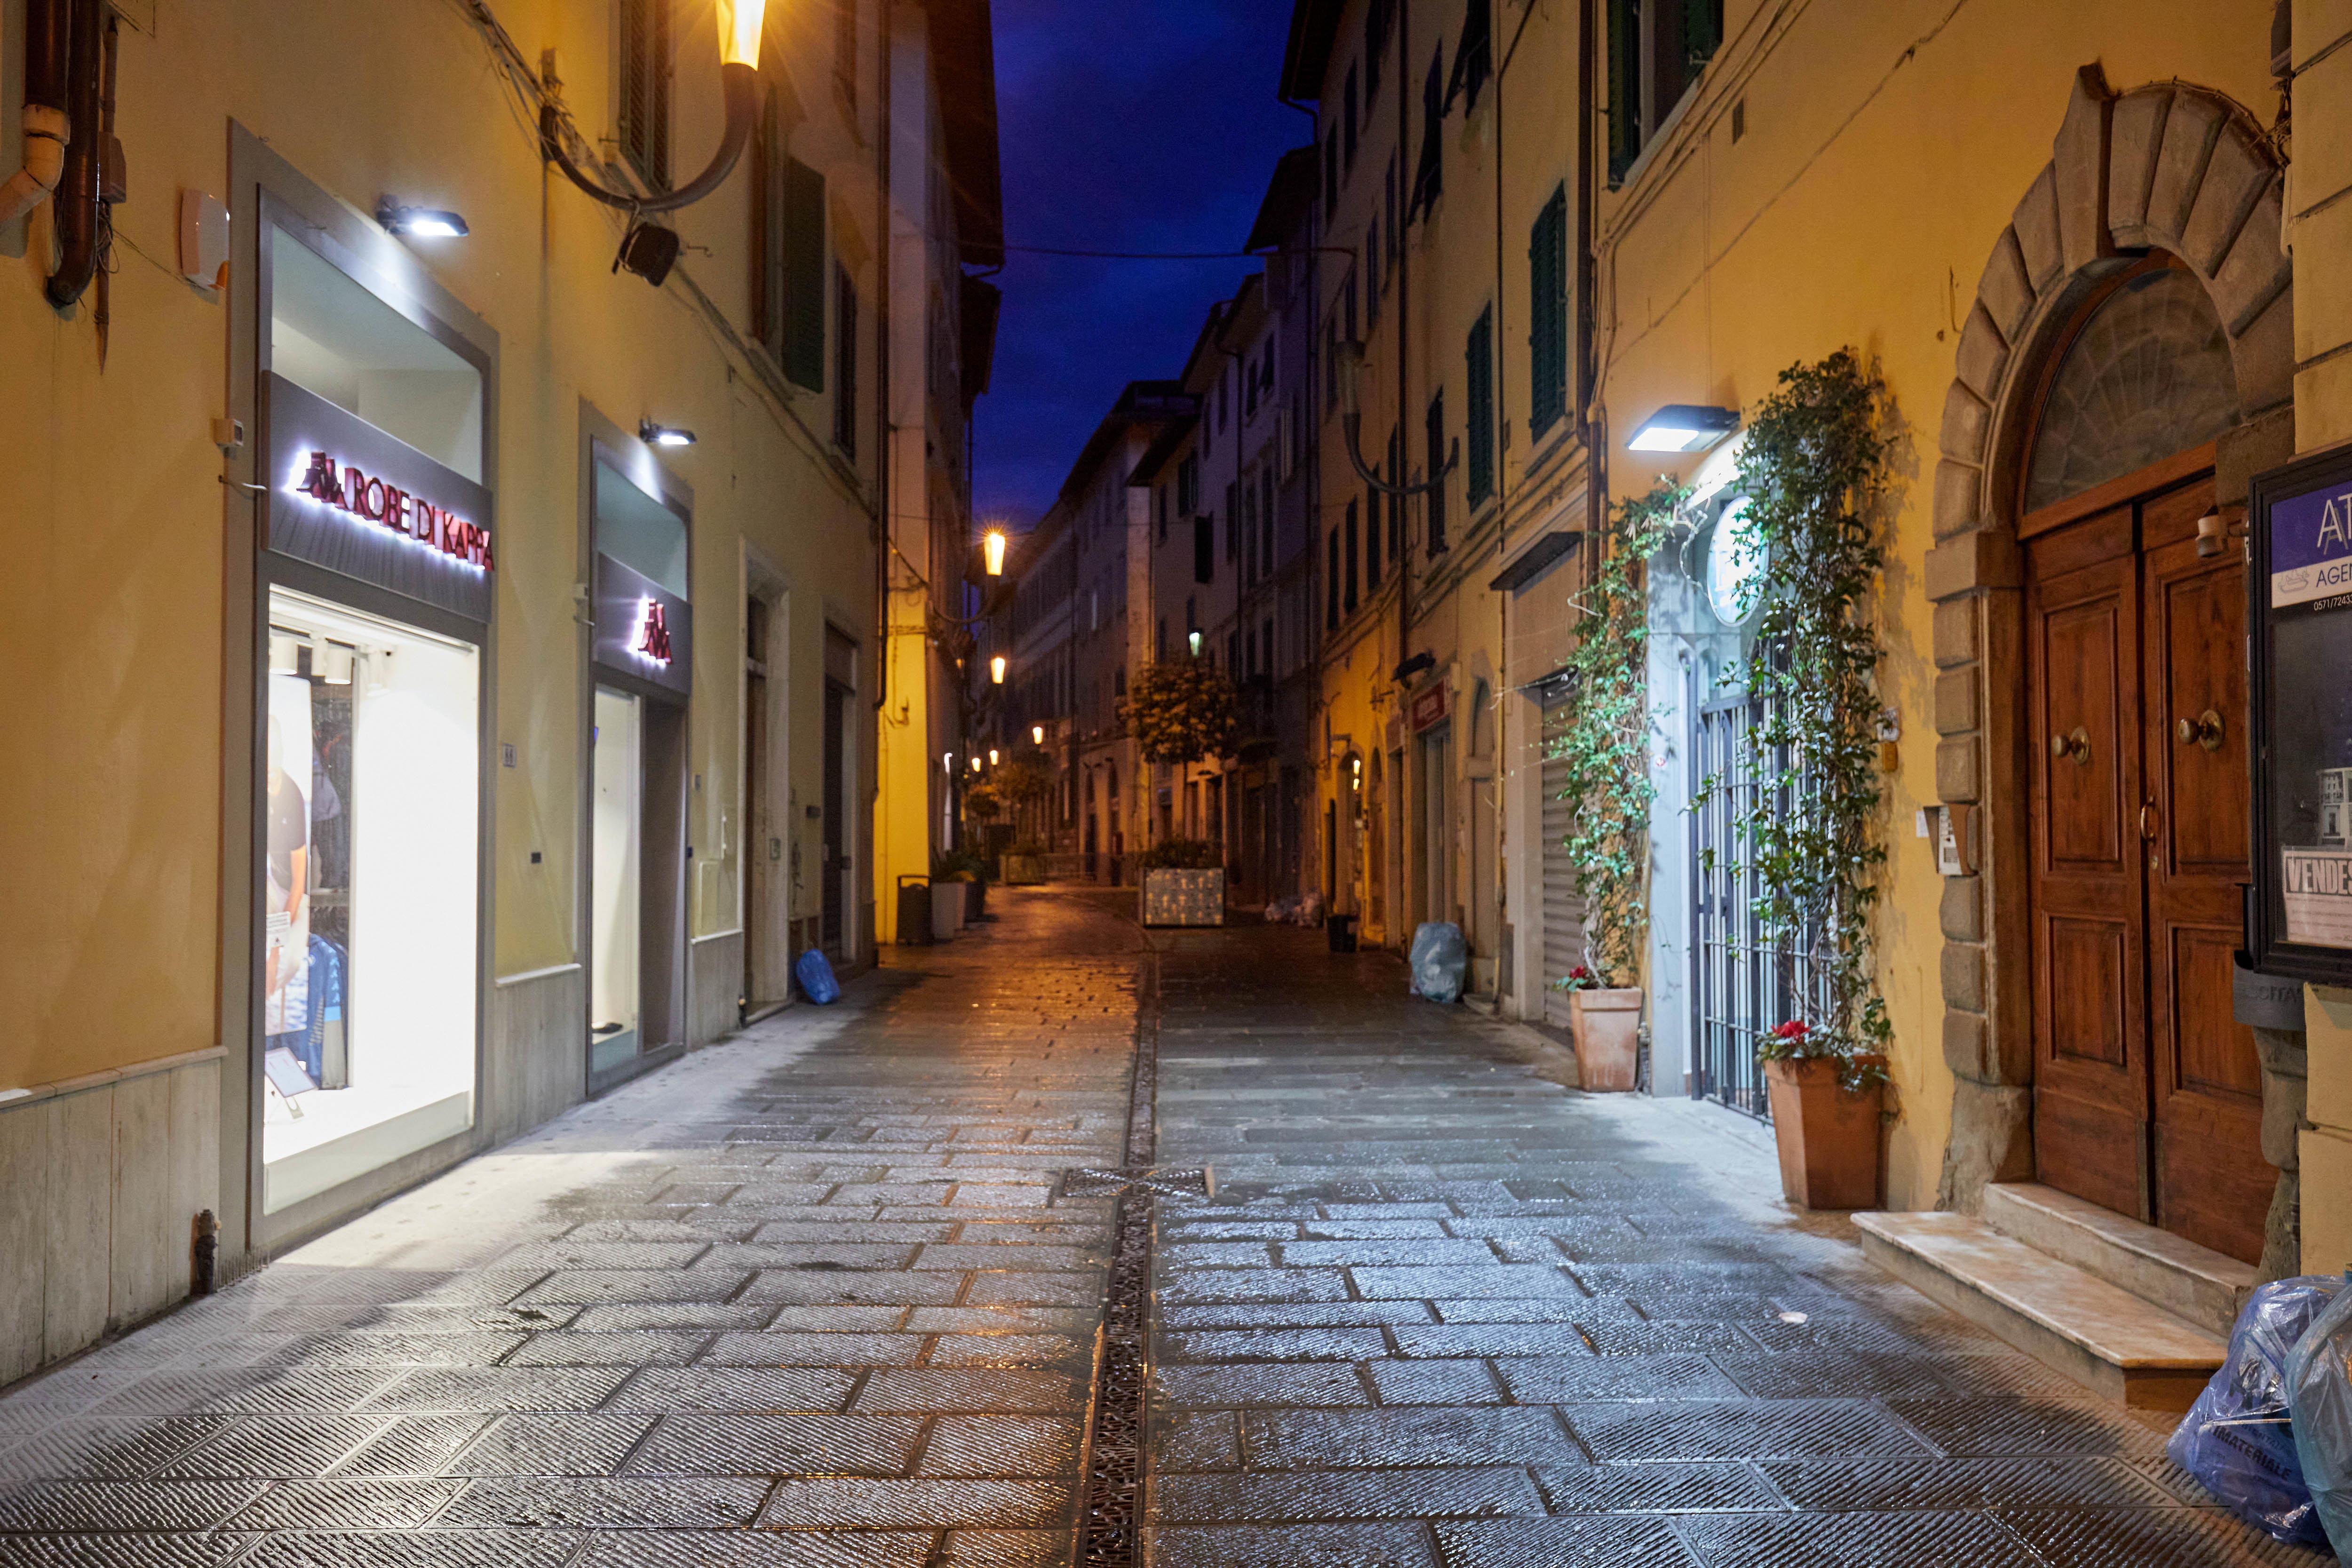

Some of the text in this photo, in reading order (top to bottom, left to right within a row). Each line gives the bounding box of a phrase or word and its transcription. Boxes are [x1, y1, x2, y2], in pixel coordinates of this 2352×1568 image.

[345, 468, 494, 572] ROBE DI KAPPA
[2316, 563, 2352, 588] AGE
[2210, 1425, 2292, 1480] IMATERIALE
